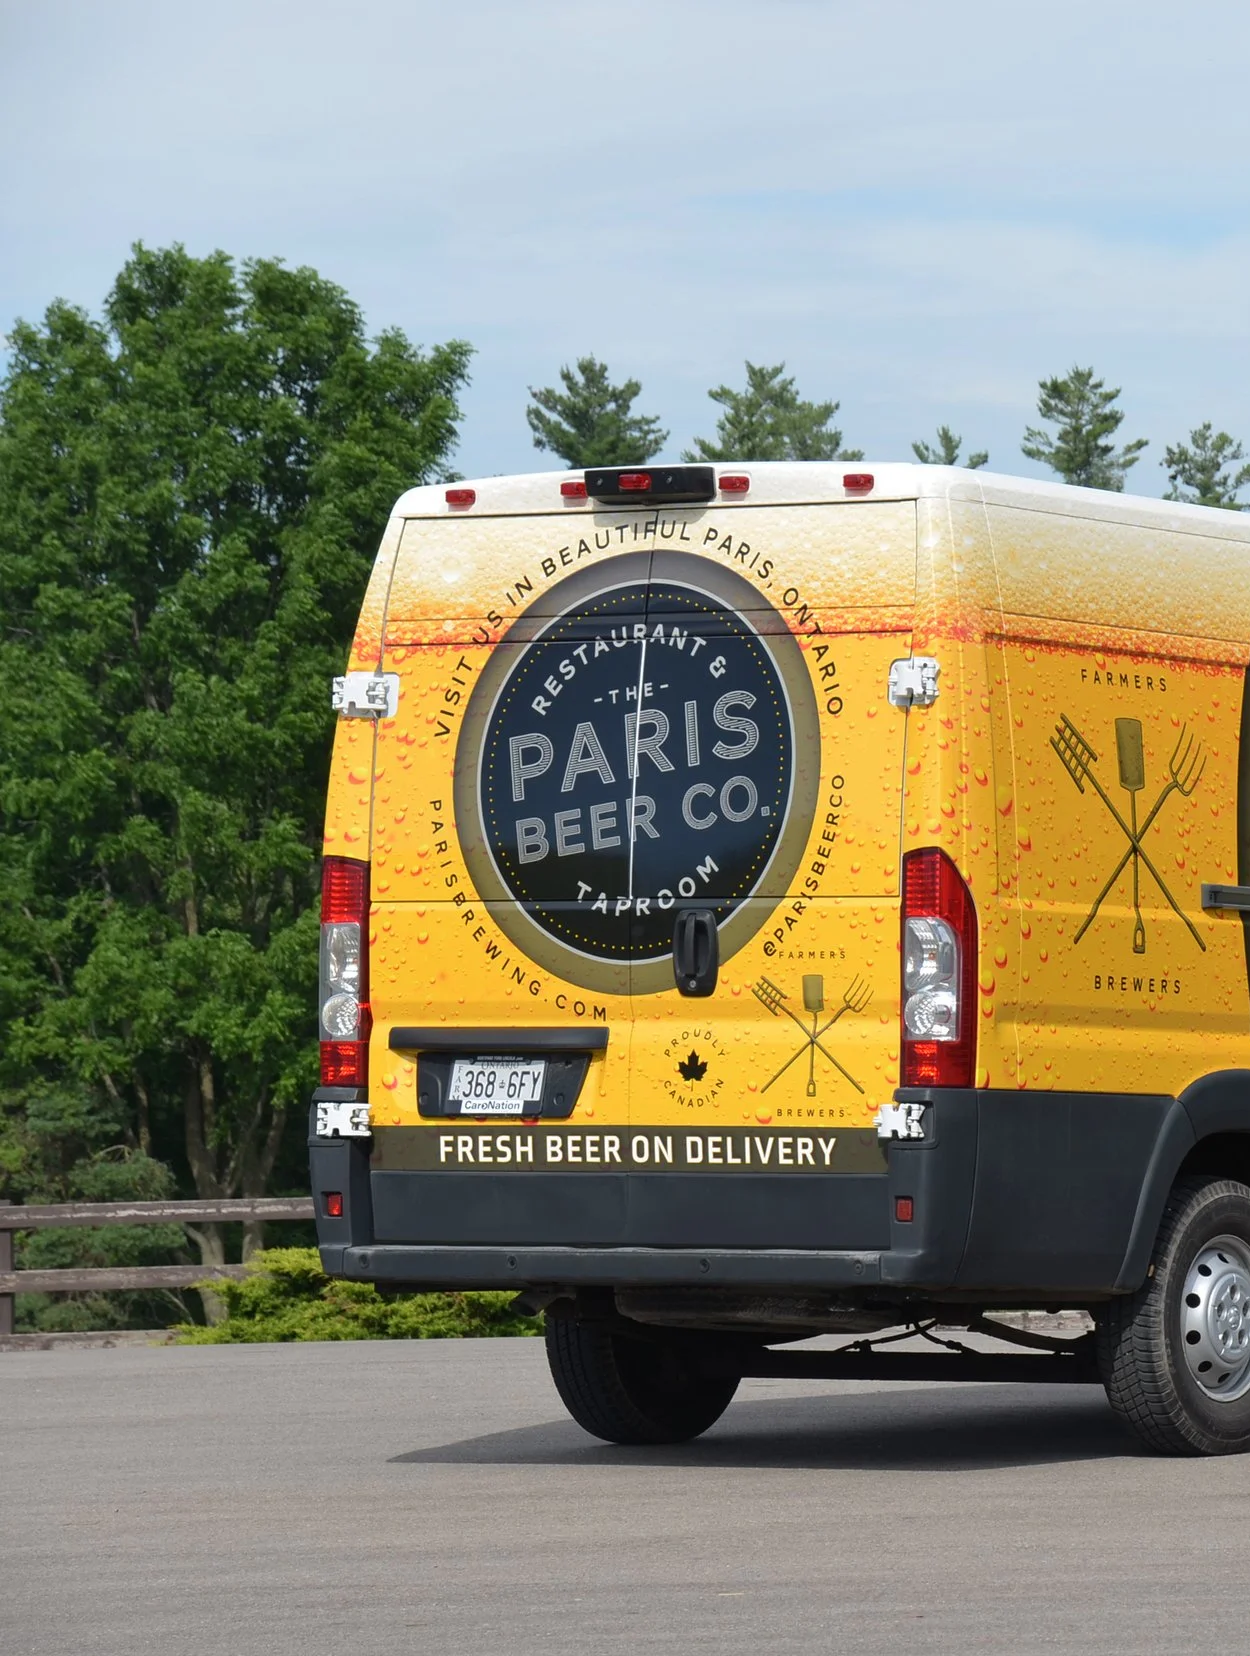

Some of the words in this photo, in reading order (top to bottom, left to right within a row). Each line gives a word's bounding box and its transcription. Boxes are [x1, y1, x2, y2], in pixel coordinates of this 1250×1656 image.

[434, 656, 473, 738] VISIT
[473, 611, 505, 645] US
[506, 575, 535, 606] IN
[541, 519, 690, 577] BEAUTIFUL
[704, 528, 774, 589] PARIS,
[783, 587, 843, 716] ONTARIO
[531, 623, 708, 716] RESTAURANT
[709, 655, 727, 679] &
[1081, 668, 1168, 692] FARMERS
[509, 690, 760, 802] PARIS
[515, 795, 660, 865] BEER
[682, 775, 770, 830] CO.
[763, 774, 845, 957] @PARISBEERCO
[577, 855, 720, 917] TAPROOM
[430, 799, 608, 1021] PARISBREWING.COM
[778, 951, 846, 959] FARMERS
[1094, 975, 1181, 994] BREWERS
[664, 1028, 726, 1057] PROUDLY
[481, 1061, 520, 1070] ONTARIO
[462, 1070, 497, 1098] 368
[506, 1070, 541, 1099] 6FY
[664, 1078, 724, 1108] CANADIAN
[776, 1108, 845, 1118] BREWERS
[439, 1135, 534, 1164] FRESH
[545, 1135, 622, 1164] BEER
[631, 1135, 673, 1164] ON
[685, 1136, 837, 1166] DELIVERY
